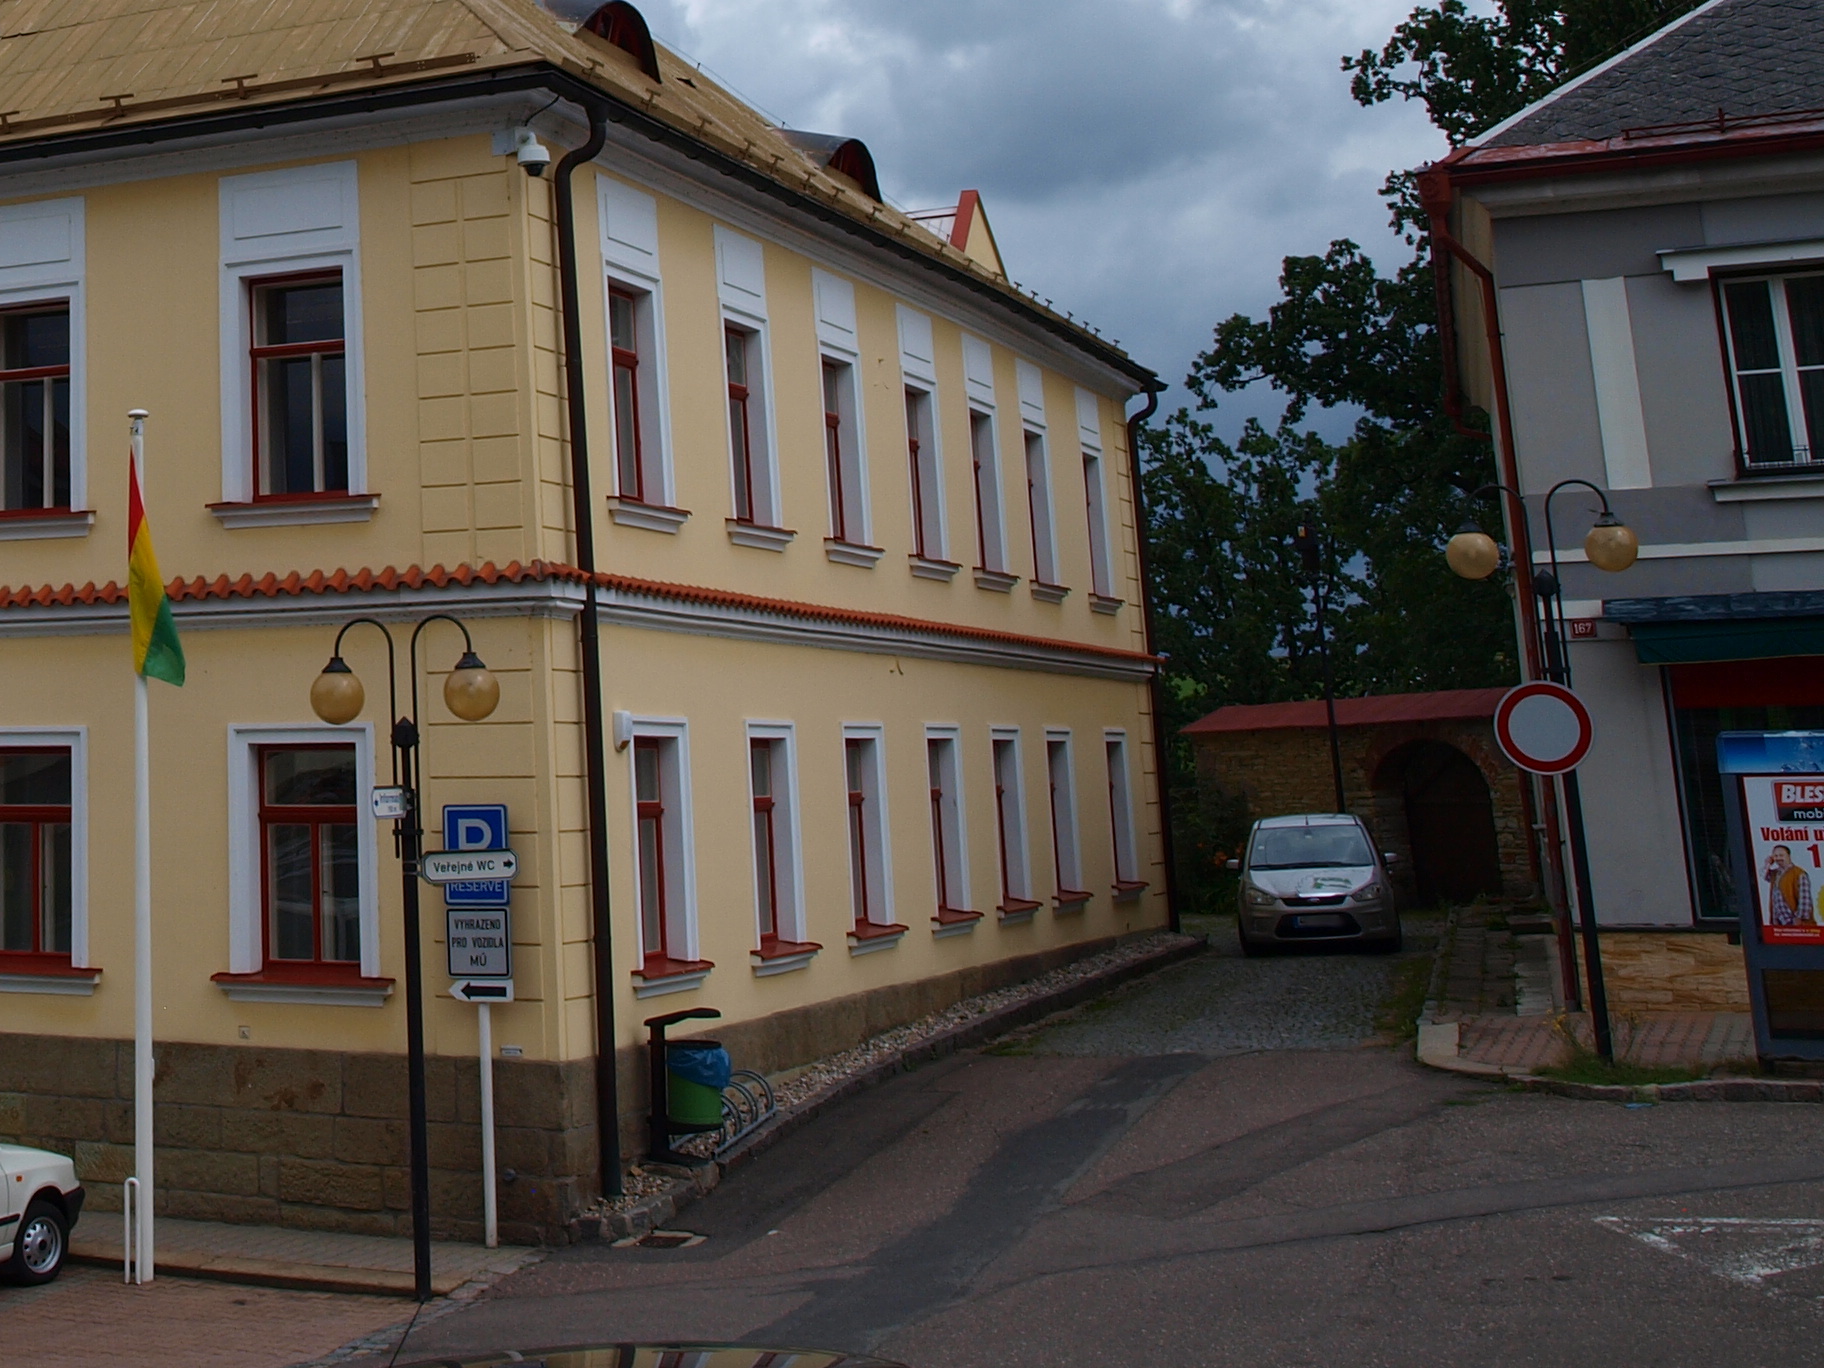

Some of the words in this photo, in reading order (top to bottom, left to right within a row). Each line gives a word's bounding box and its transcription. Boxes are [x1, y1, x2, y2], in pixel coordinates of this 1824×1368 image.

[1573, 622, 1592, 634] 167
[1781, 784, 1824, 803] BLES
[1760, 826, 1808, 842] Volání
[433, 861, 473, 874] Veřejné
[477, 860, 495, 871] WC
[454, 918, 501, 930] VYHRAZENO
[452, 937, 468, 948] PRO
[472, 937, 504, 948] VOZIDLA
[470, 952, 487, 966] MÚ
